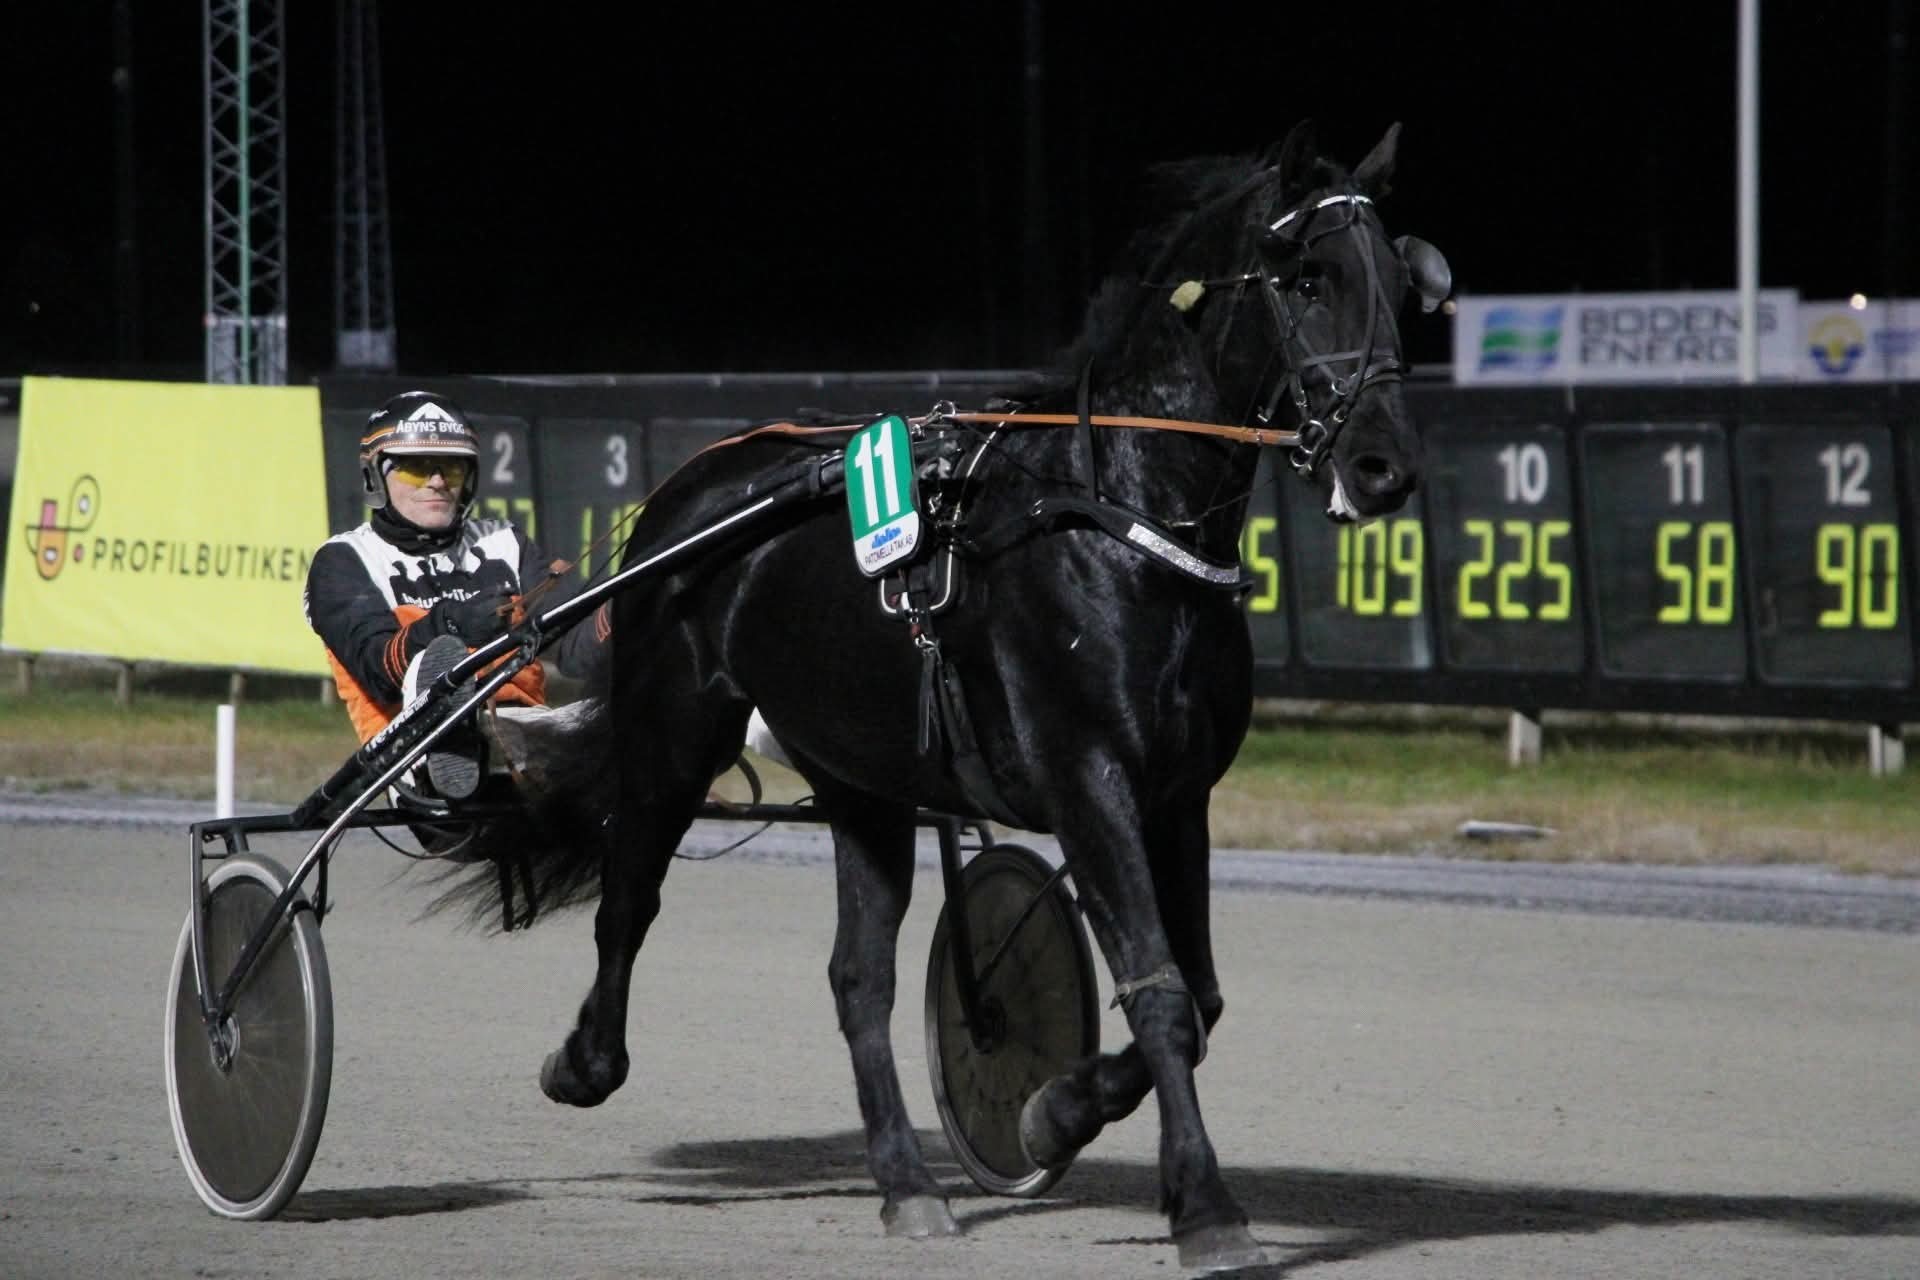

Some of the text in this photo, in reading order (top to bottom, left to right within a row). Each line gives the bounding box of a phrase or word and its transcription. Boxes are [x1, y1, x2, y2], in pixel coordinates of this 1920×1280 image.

[1579, 305, 1778, 336] BODENS
[1579, 335, 1740, 363] ENERG
[438, 421, 465, 434] BYGG
[493, 432, 514, 483] 2
[606, 434, 629, 486] 3
[855, 421, 900, 527] 11
[1497, 443, 1549, 503] 10
[1660, 443, 1704, 504] 11
[1818, 443, 1871, 506] 12
[1238, 517, 1279, 612] 5
[1336, 520, 1423, 616] 109
[1458, 520, 1571, 619] 225
[1656, 521, 1735, 624] 58
[1816, 523, 1898, 627] 90
